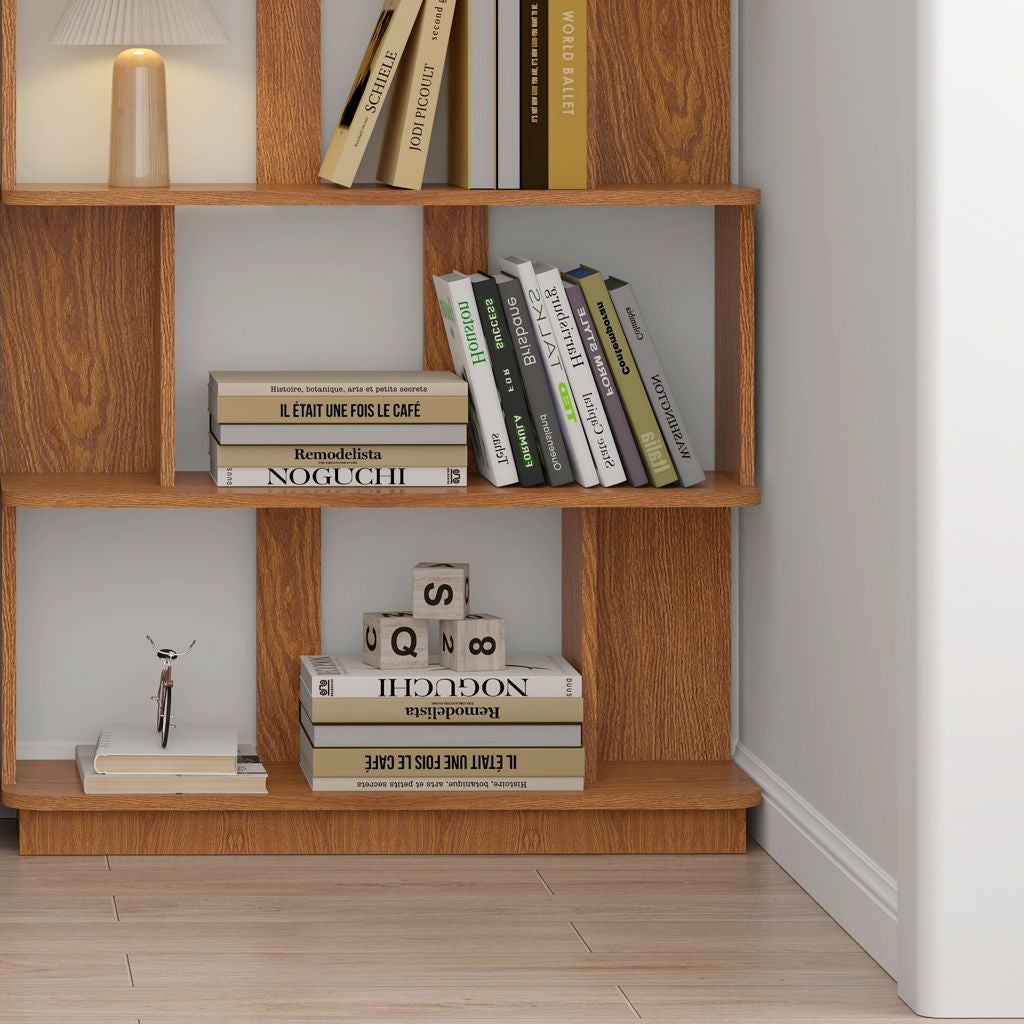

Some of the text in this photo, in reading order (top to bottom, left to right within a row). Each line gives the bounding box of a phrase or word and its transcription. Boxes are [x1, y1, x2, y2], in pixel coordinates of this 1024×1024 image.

[431, 6, 443, 41] second
[562, 10, 575, 116] WORLD BALLET
[364, 50, 398, 114] SCHIELE
[409, 63, 435, 152] JODI PICOULT
[280, 400, 421, 417] IL ÉTAIT UNE FOIS LE CAFÉ
[294, 448, 382, 461] Remodelista
[267, 468, 406, 485] NOGUCHI
[391, 626, 418, 658] Q
[469, 636, 496, 656] 8
[378, 678, 528, 697] NOGUCHI
[405, 706, 500, 720] Remodelista
